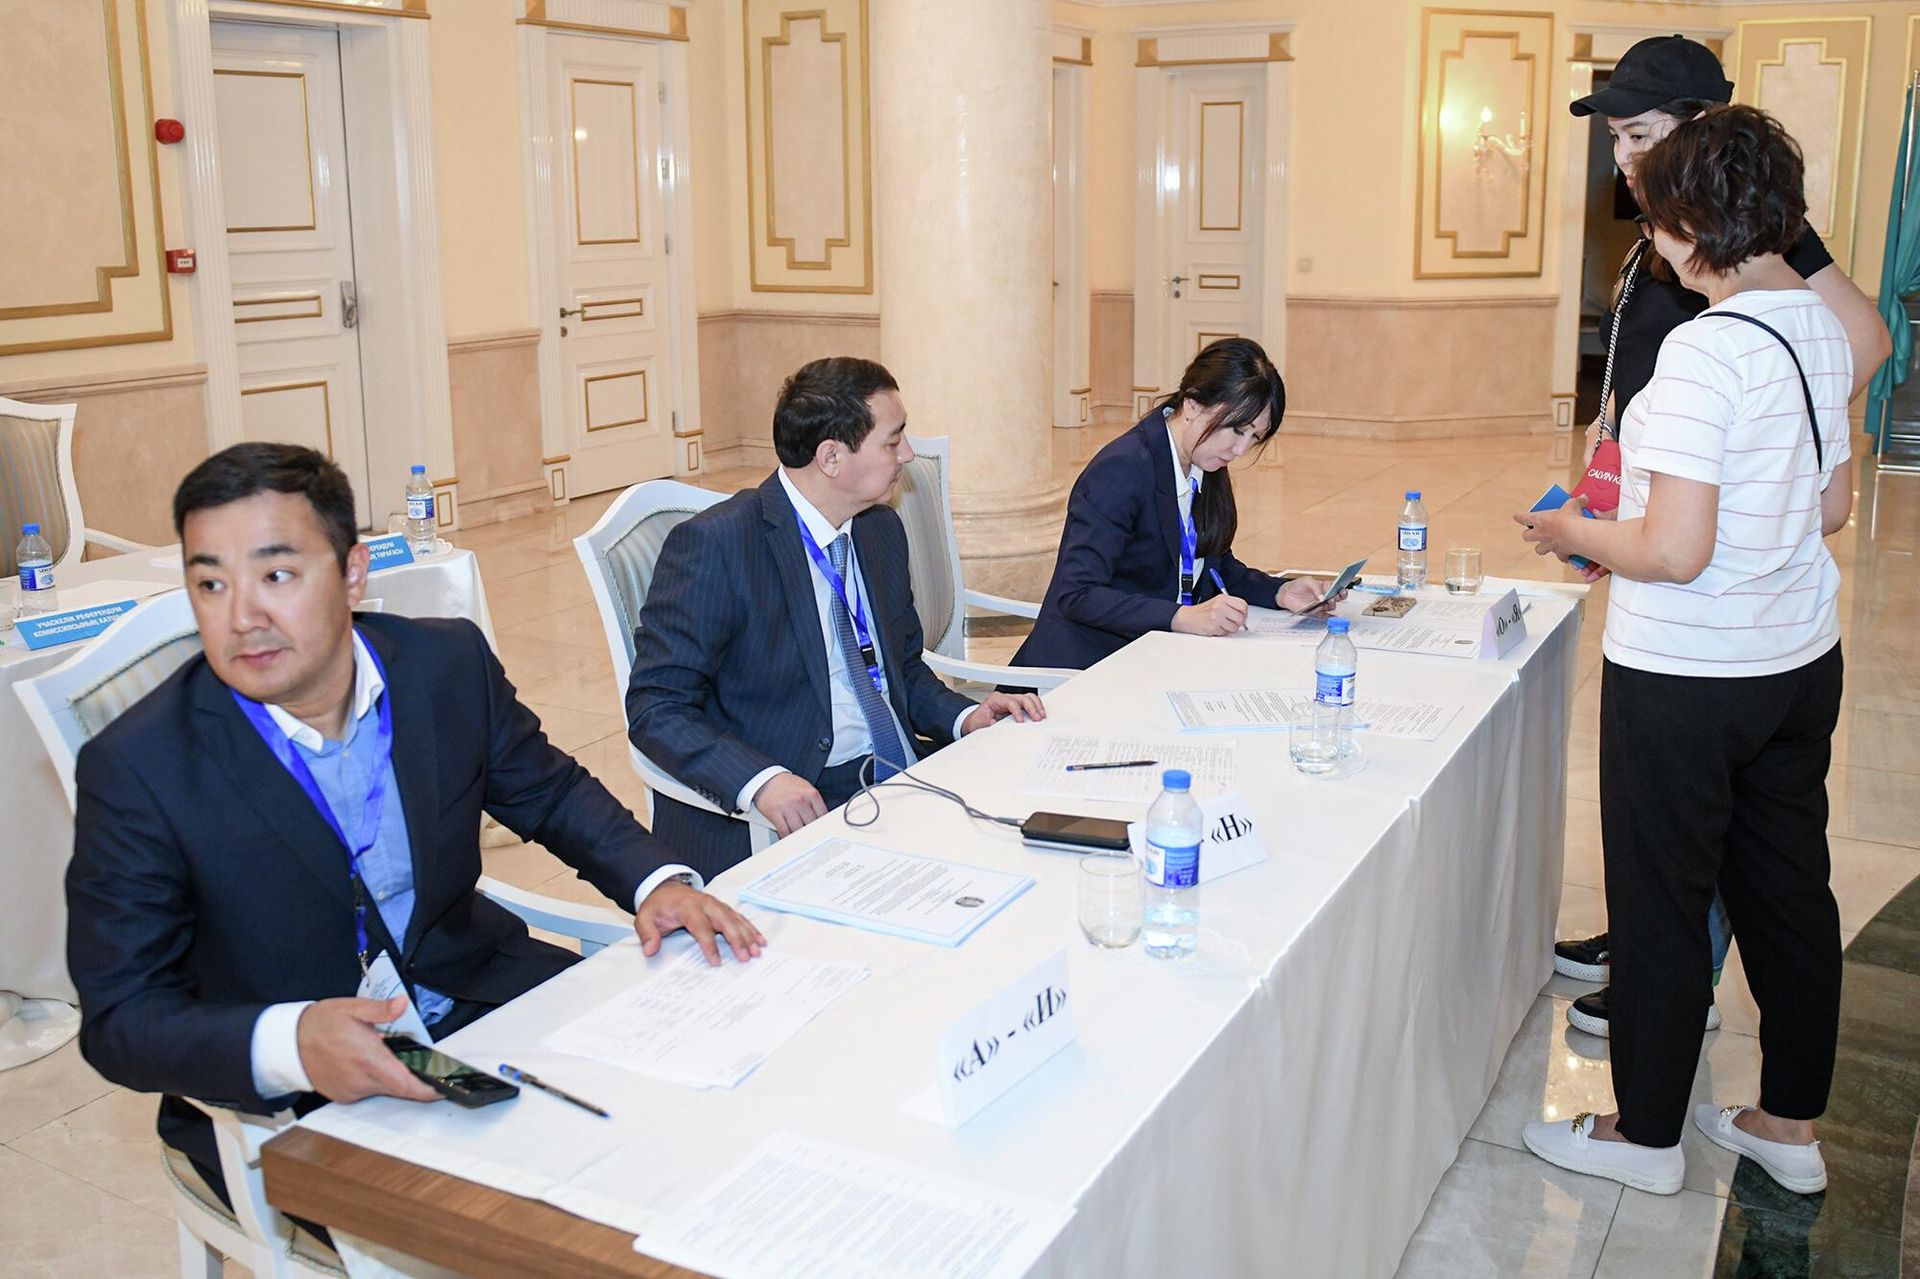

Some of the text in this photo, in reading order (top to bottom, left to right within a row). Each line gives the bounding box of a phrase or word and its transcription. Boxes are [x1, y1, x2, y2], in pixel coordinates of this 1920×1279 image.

[1588, 468, 1614, 482] CALVIN
[1211, 813, 1252, 844] «Н»
[953, 1037, 999, 1082] «А»
[1023, 985, 1066, 1032] «И»
